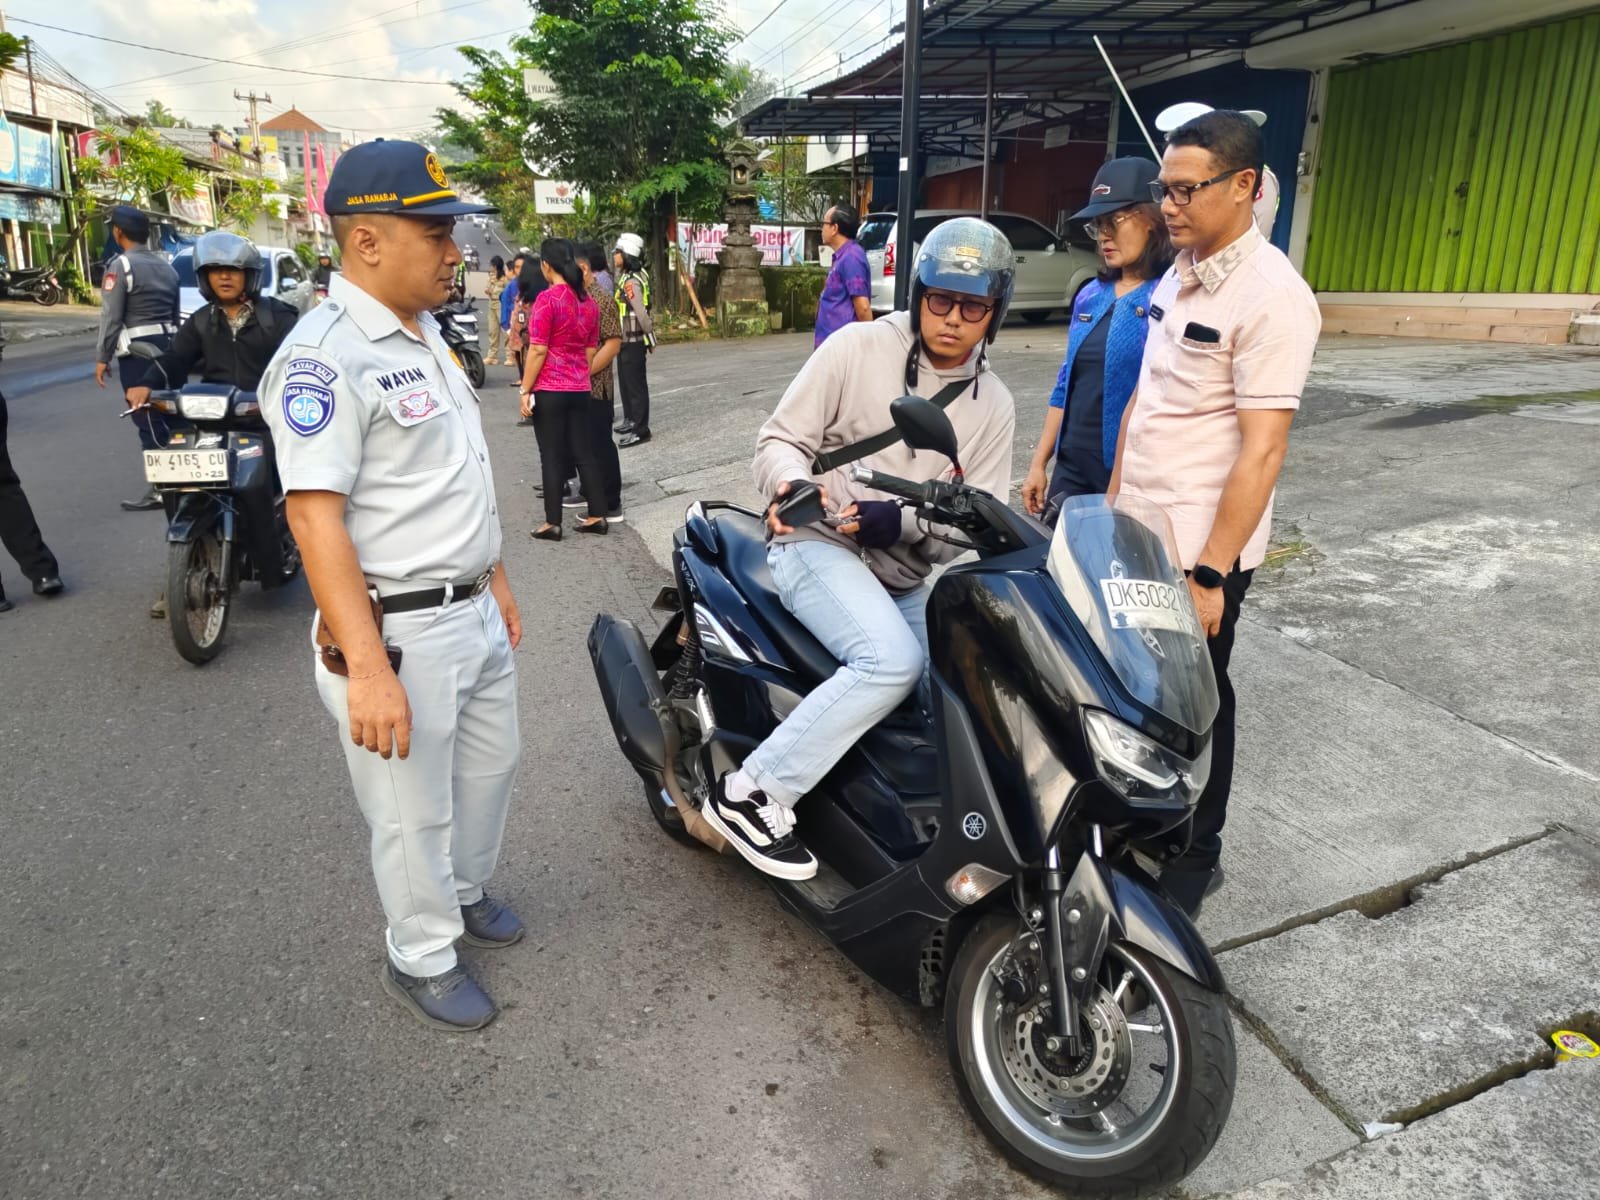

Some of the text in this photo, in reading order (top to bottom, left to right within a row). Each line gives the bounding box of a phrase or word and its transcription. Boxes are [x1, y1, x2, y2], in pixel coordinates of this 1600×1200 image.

[347, 192, 398, 205] JASA RAHARJA
[376, 367, 427, 391] WAYAN
[146, 453, 224, 466] DK 4165 CU
